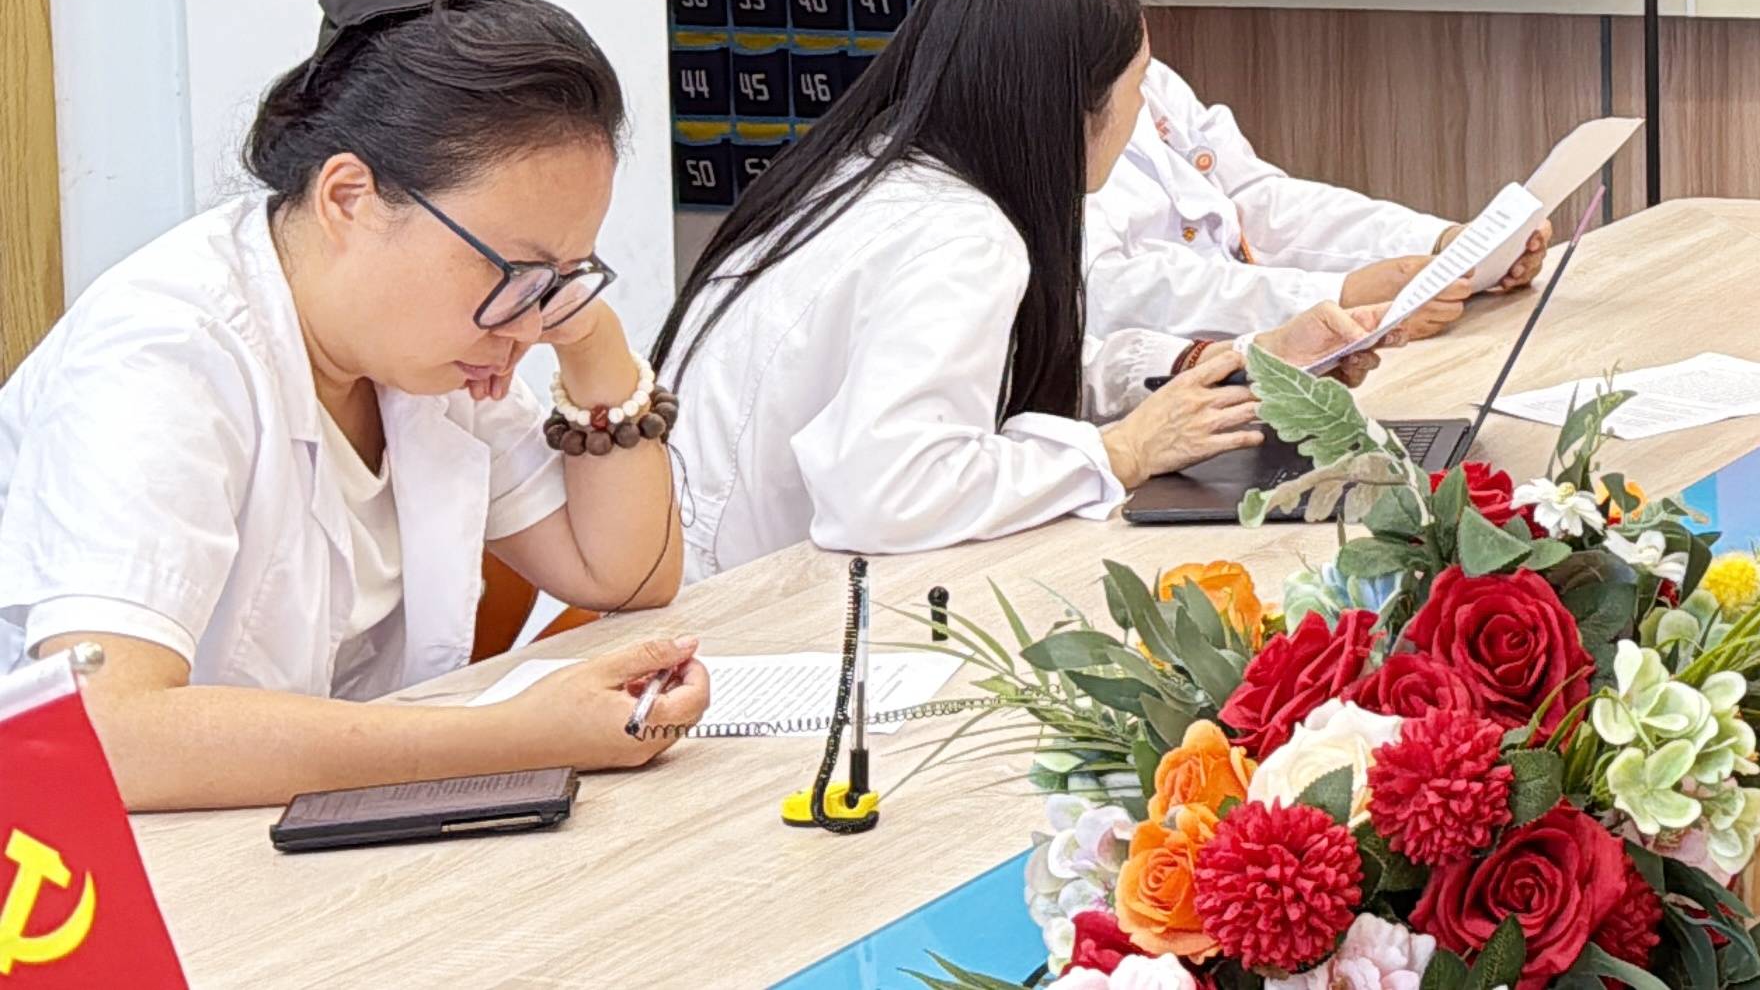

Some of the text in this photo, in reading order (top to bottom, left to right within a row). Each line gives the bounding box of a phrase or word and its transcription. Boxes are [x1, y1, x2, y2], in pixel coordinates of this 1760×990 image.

[681, 70, 831, 101] 44 45 46
[686, 160, 716, 187] 50
